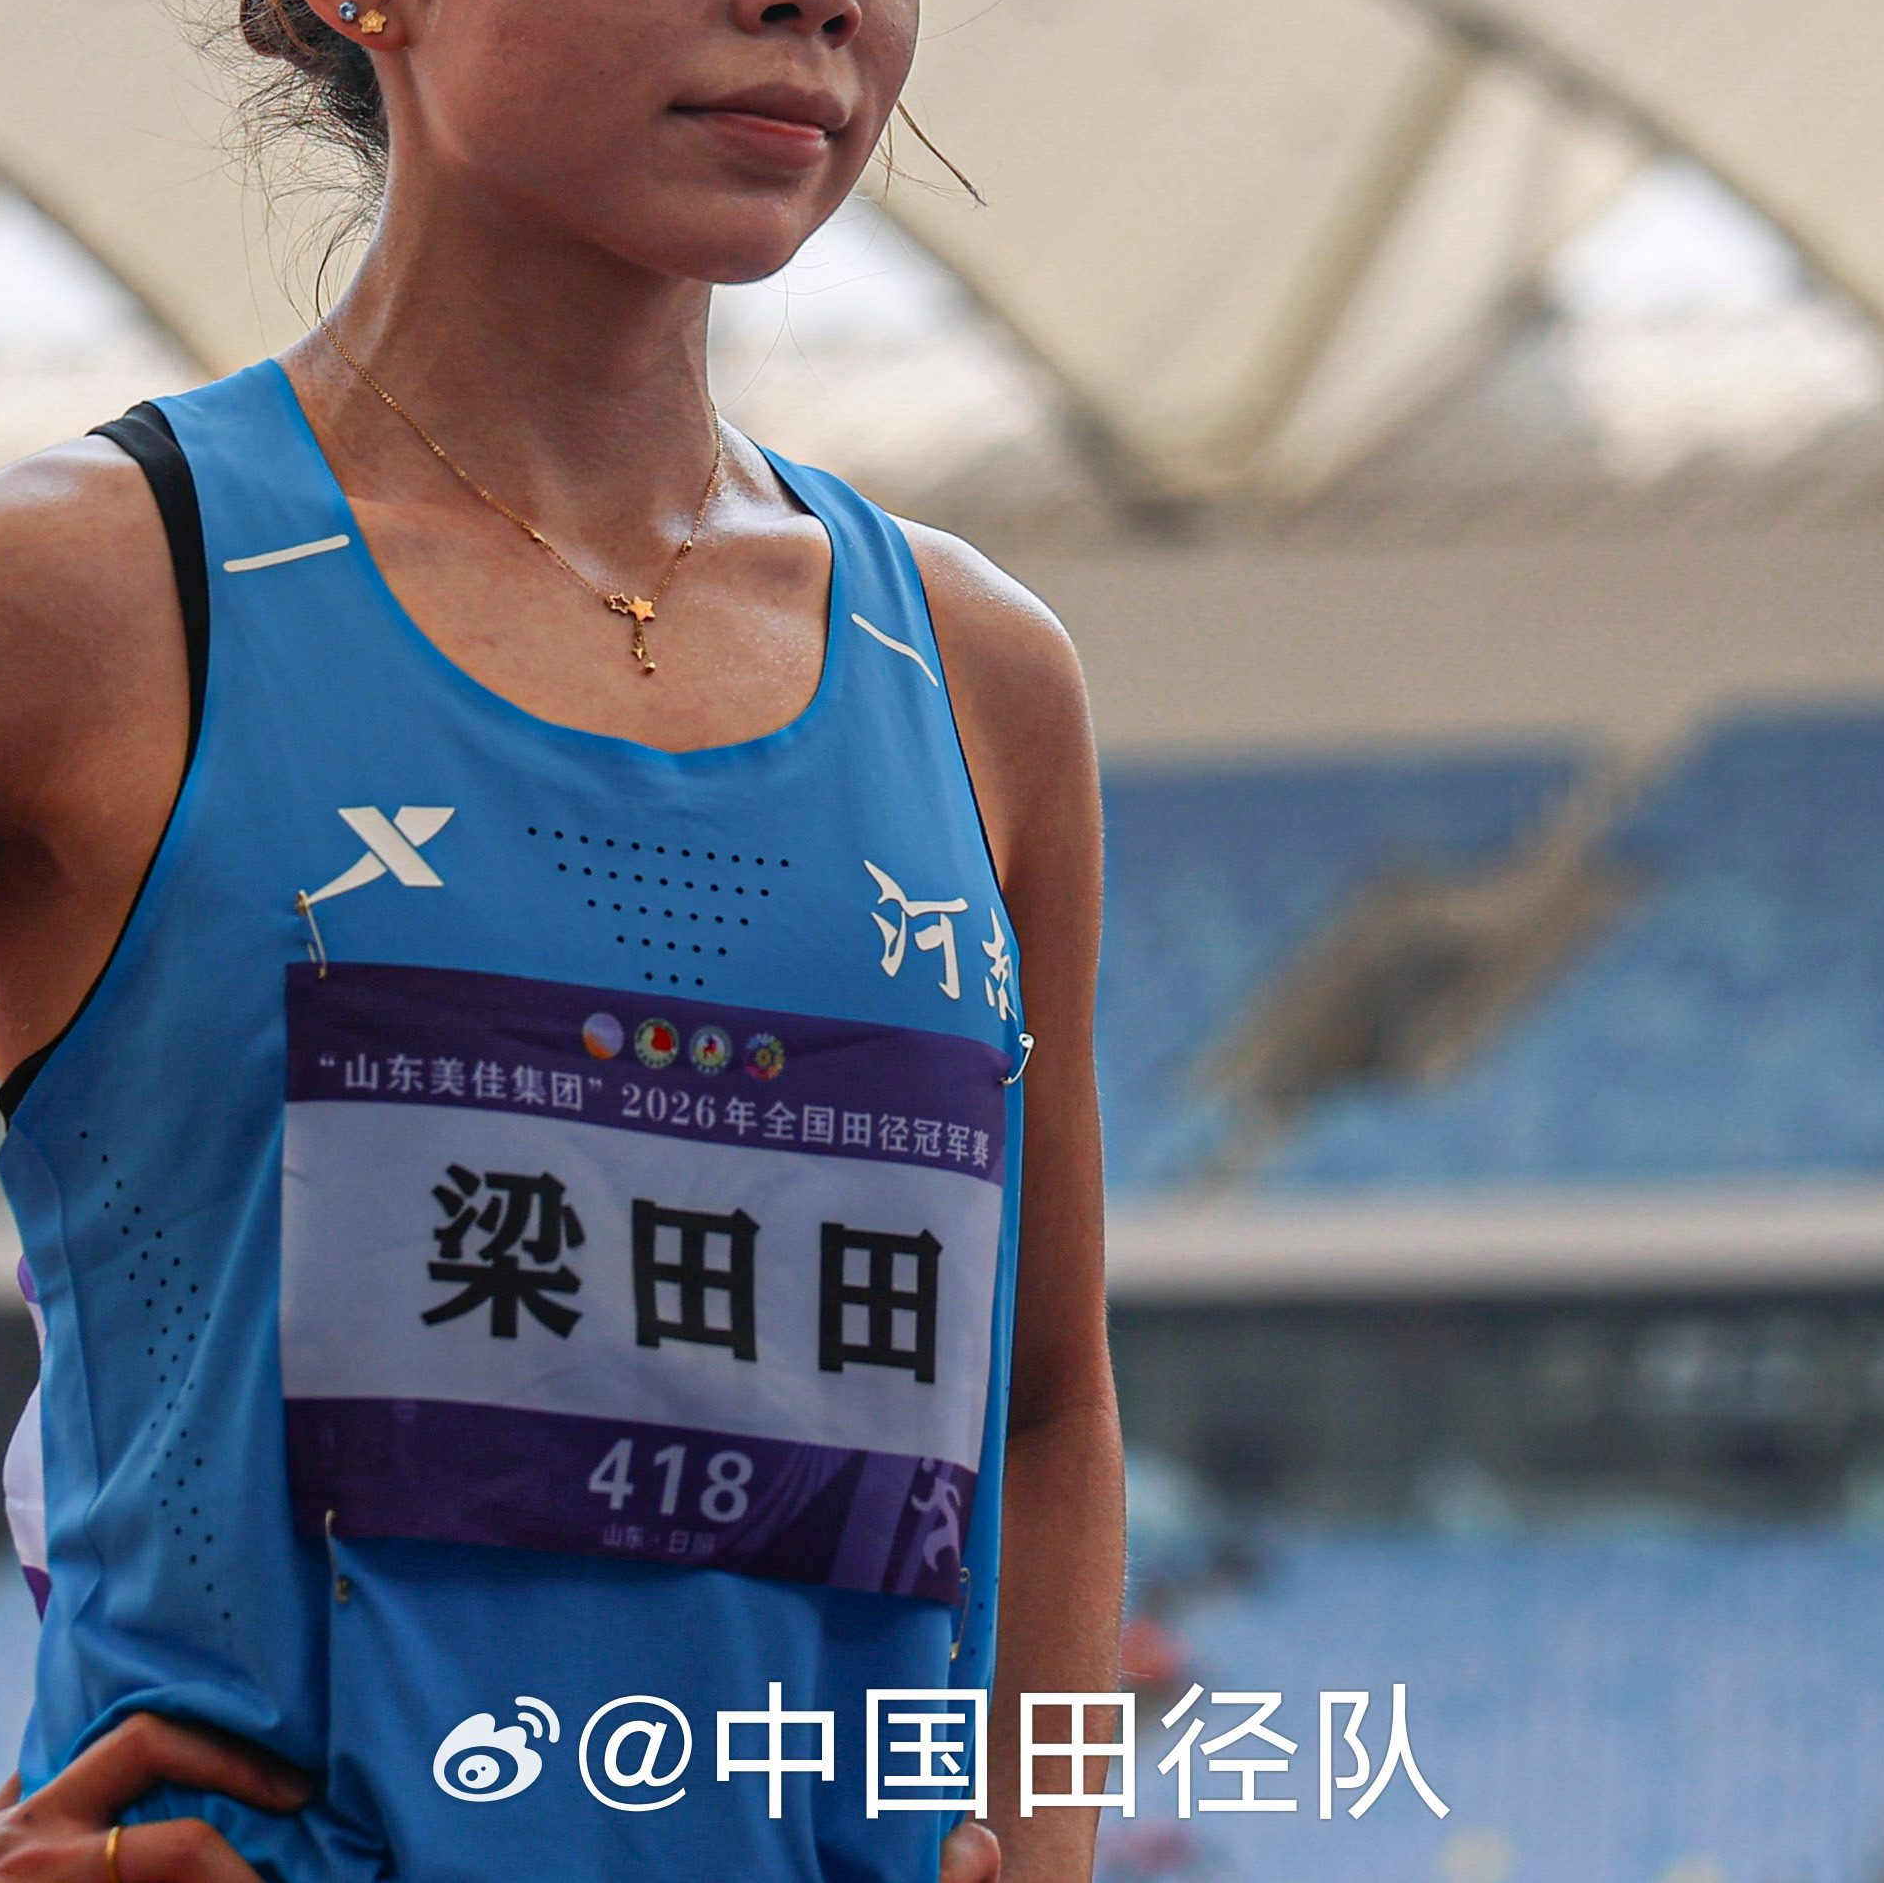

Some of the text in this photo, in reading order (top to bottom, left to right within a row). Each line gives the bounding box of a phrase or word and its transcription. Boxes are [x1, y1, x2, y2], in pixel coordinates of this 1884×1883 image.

[318, 1052, 990, 1169] “山东美佳集团” 2026年全国田径冠军赛
[420, 1163, 944, 1385] 梁田田
[587, 1437, 755, 1524] 418
